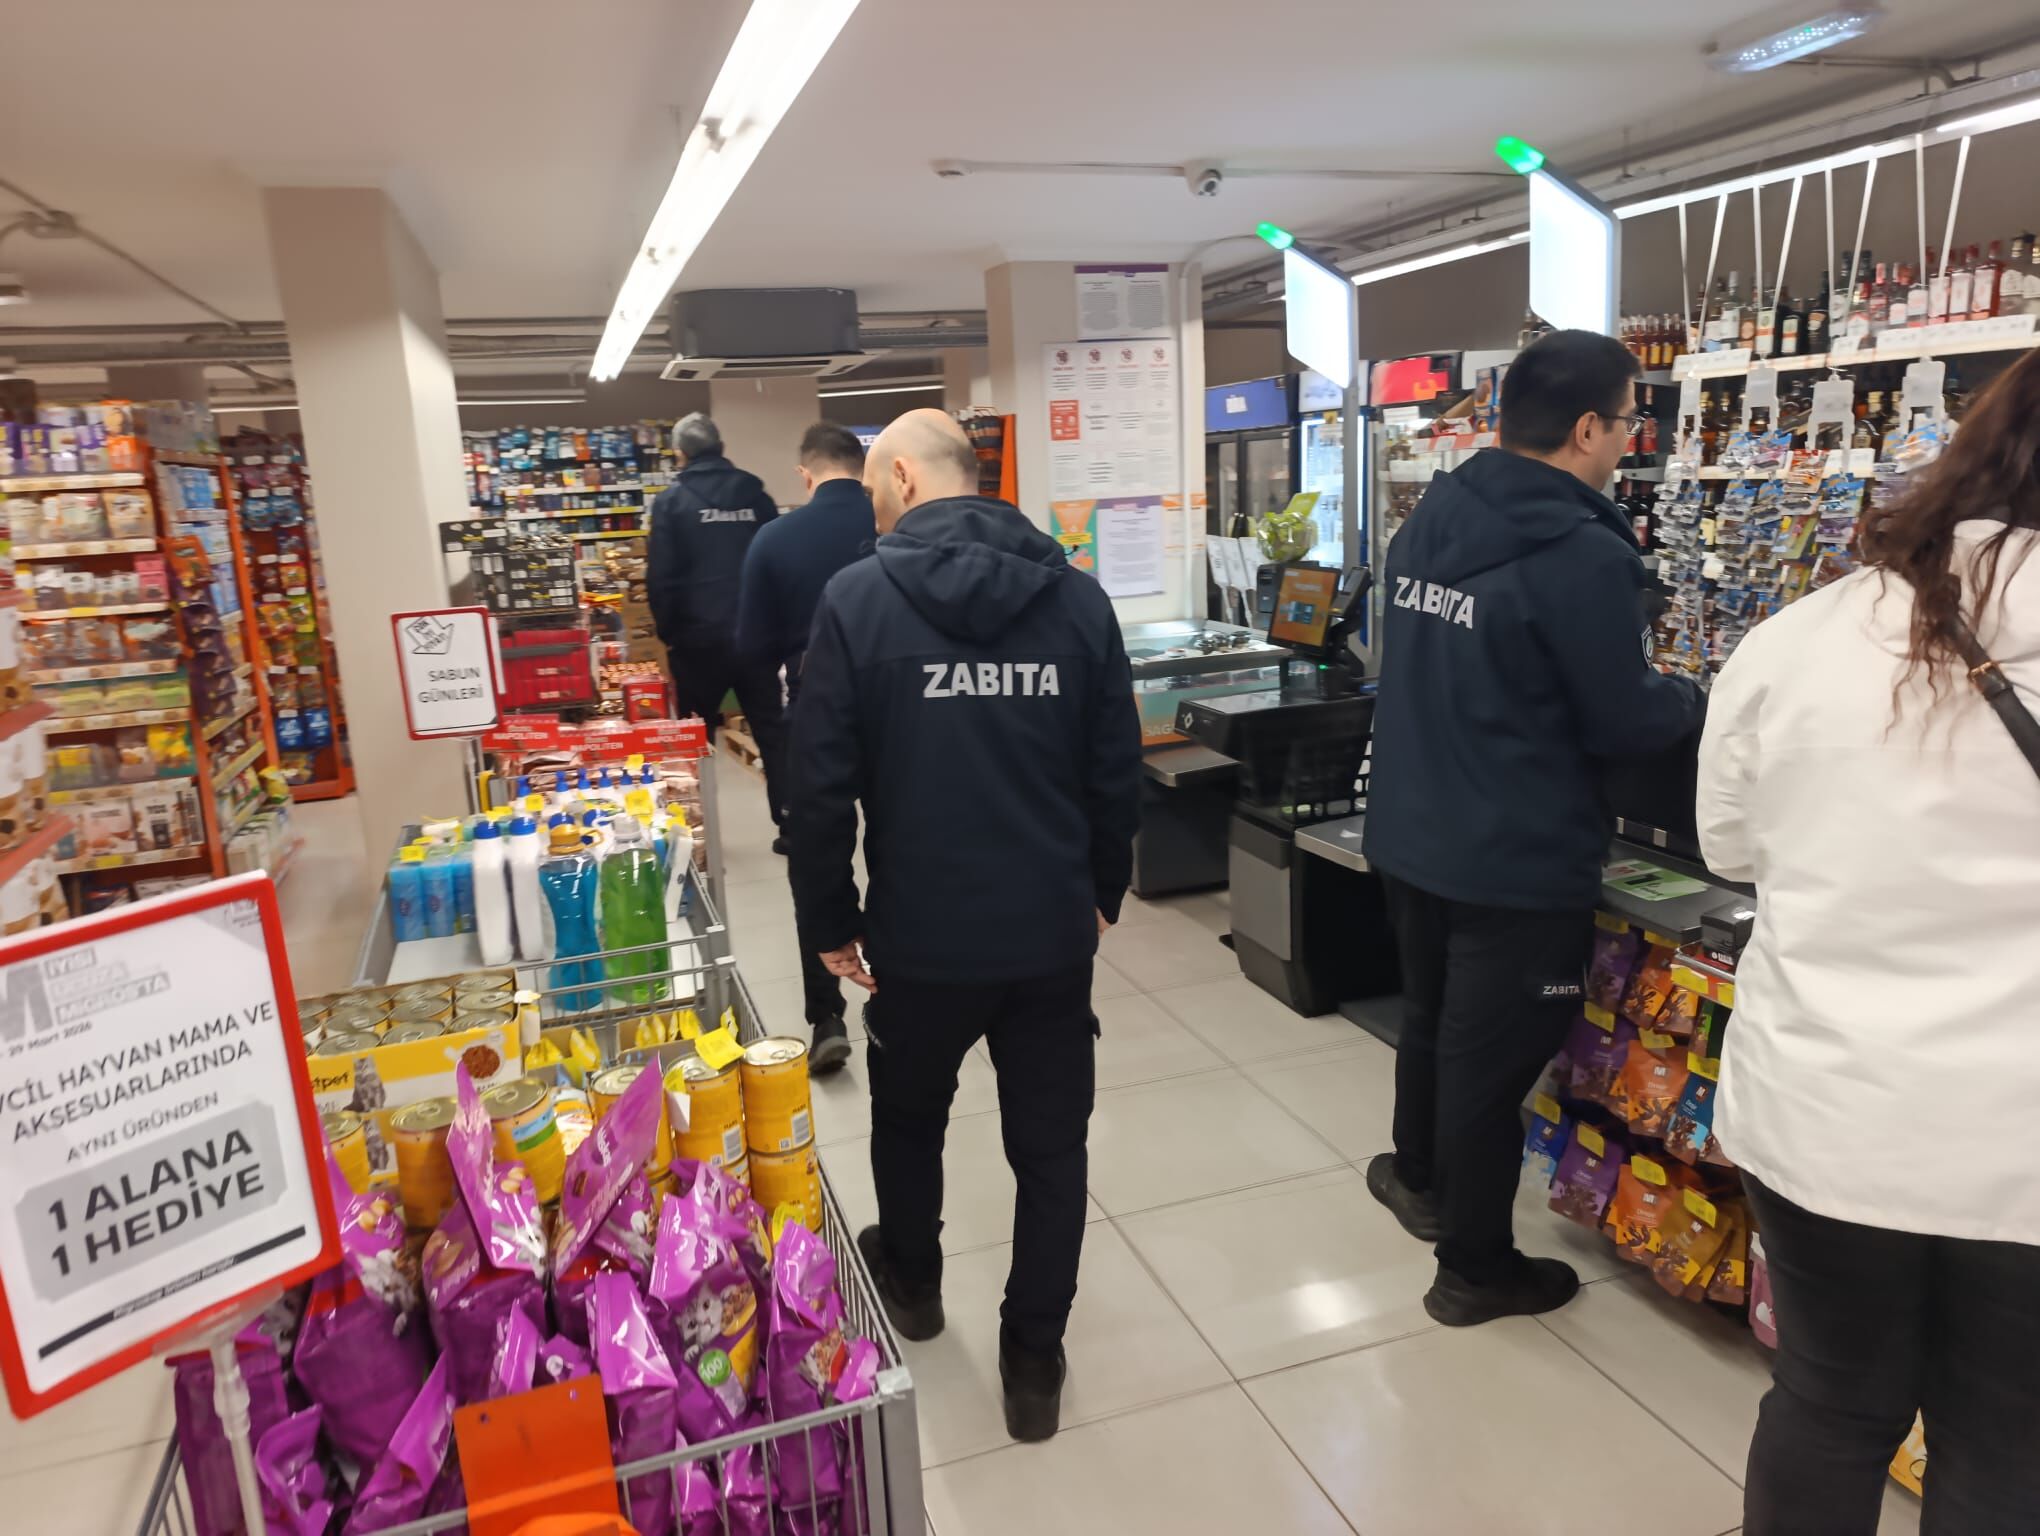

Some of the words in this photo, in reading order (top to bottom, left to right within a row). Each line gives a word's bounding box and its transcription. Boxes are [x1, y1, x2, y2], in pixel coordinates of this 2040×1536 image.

[1393, 576, 1475, 629] ZABITA
[428, 667, 480, 682] SABUN
[922, 662, 1060, 698] ZABITA
[1543, 985, 1580, 995] ZABITA
[58, 1039, 163, 1093] HAYVAN
[168, 1013, 240, 1054] MAMA
[243, 1001, 275, 1025] VE
[13, 1039, 253, 1144] AKSESUARLARINDA
[66, 1129, 118, 1163] AYNI
[123, 1090, 219, 1140] ÜRÜNDEN
[48, 1199, 68, 1232] 1
[84, 1127, 254, 1222] ALANA
[51, 1243, 71, 1277] 1
[84, 1162, 265, 1265] HEDİYE
